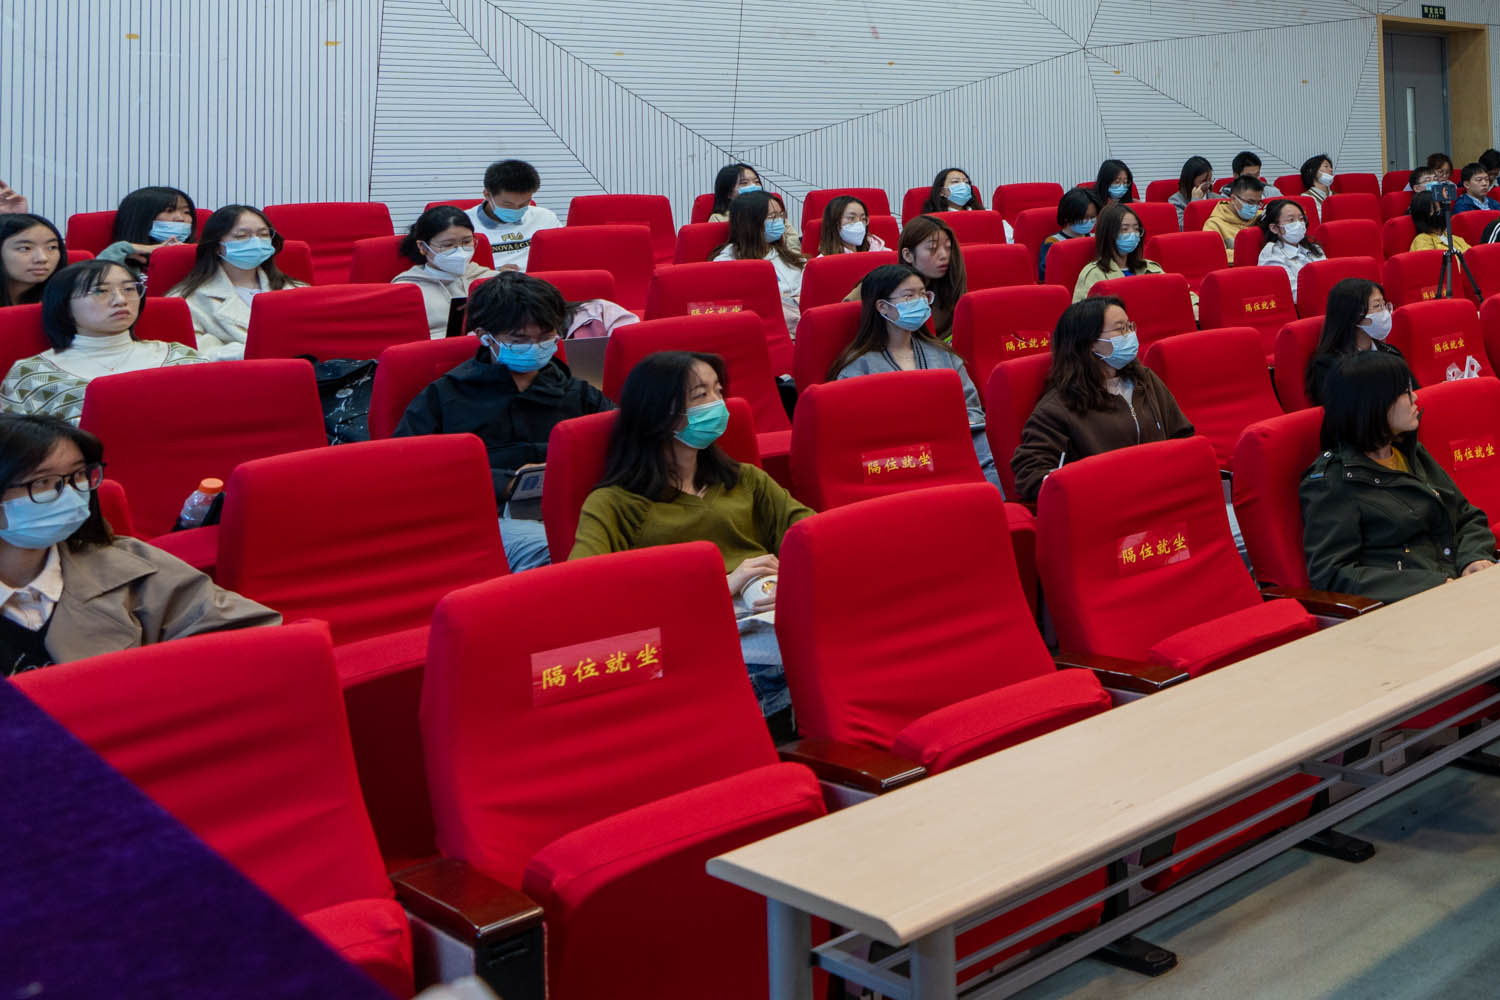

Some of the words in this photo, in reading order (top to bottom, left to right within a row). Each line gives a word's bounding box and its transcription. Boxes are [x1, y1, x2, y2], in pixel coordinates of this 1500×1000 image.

[867, 451, 932, 475] 隔位就坐
[1122, 533, 1187, 565] 隔位就坐
[541, 643, 660, 690] 隔位就坐
